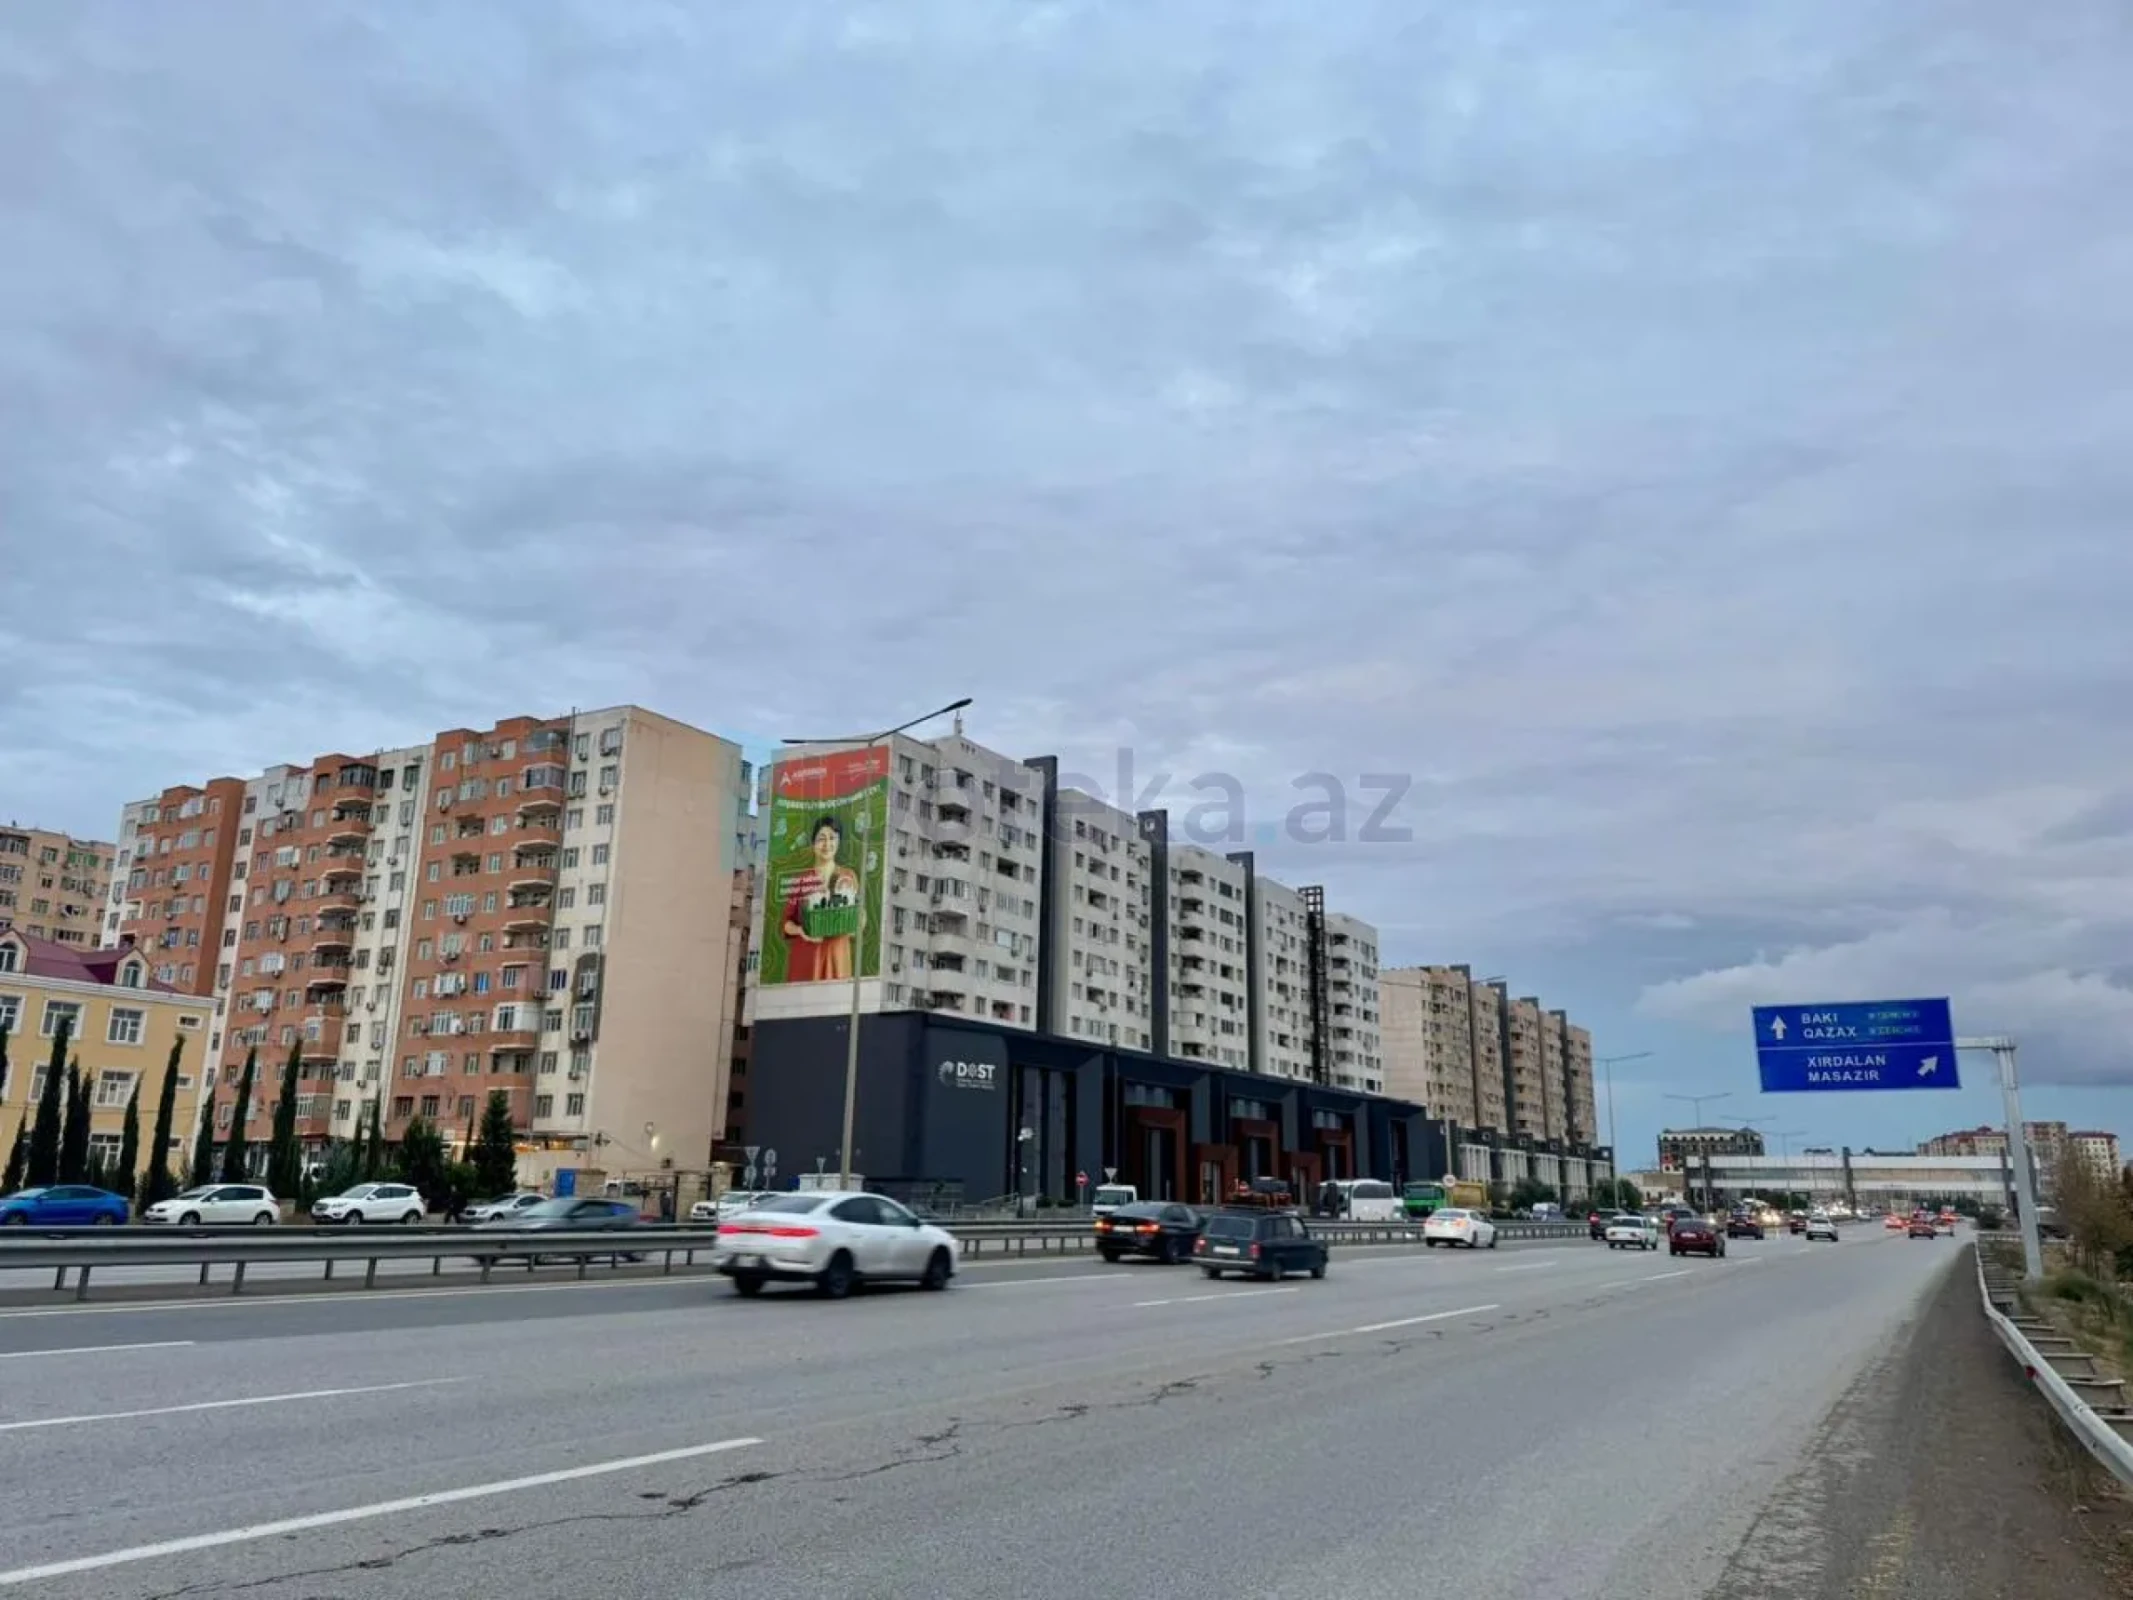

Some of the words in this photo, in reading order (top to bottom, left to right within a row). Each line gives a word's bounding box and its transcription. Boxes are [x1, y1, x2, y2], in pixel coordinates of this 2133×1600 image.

[1801, 1012, 1838, 1024] BAKI
[1803, 1026, 1857, 1039] QAZAX
[1807, 1055, 1886, 1068] XIRDALAN
[1808, 1070, 1880, 1082] MASAZIR
